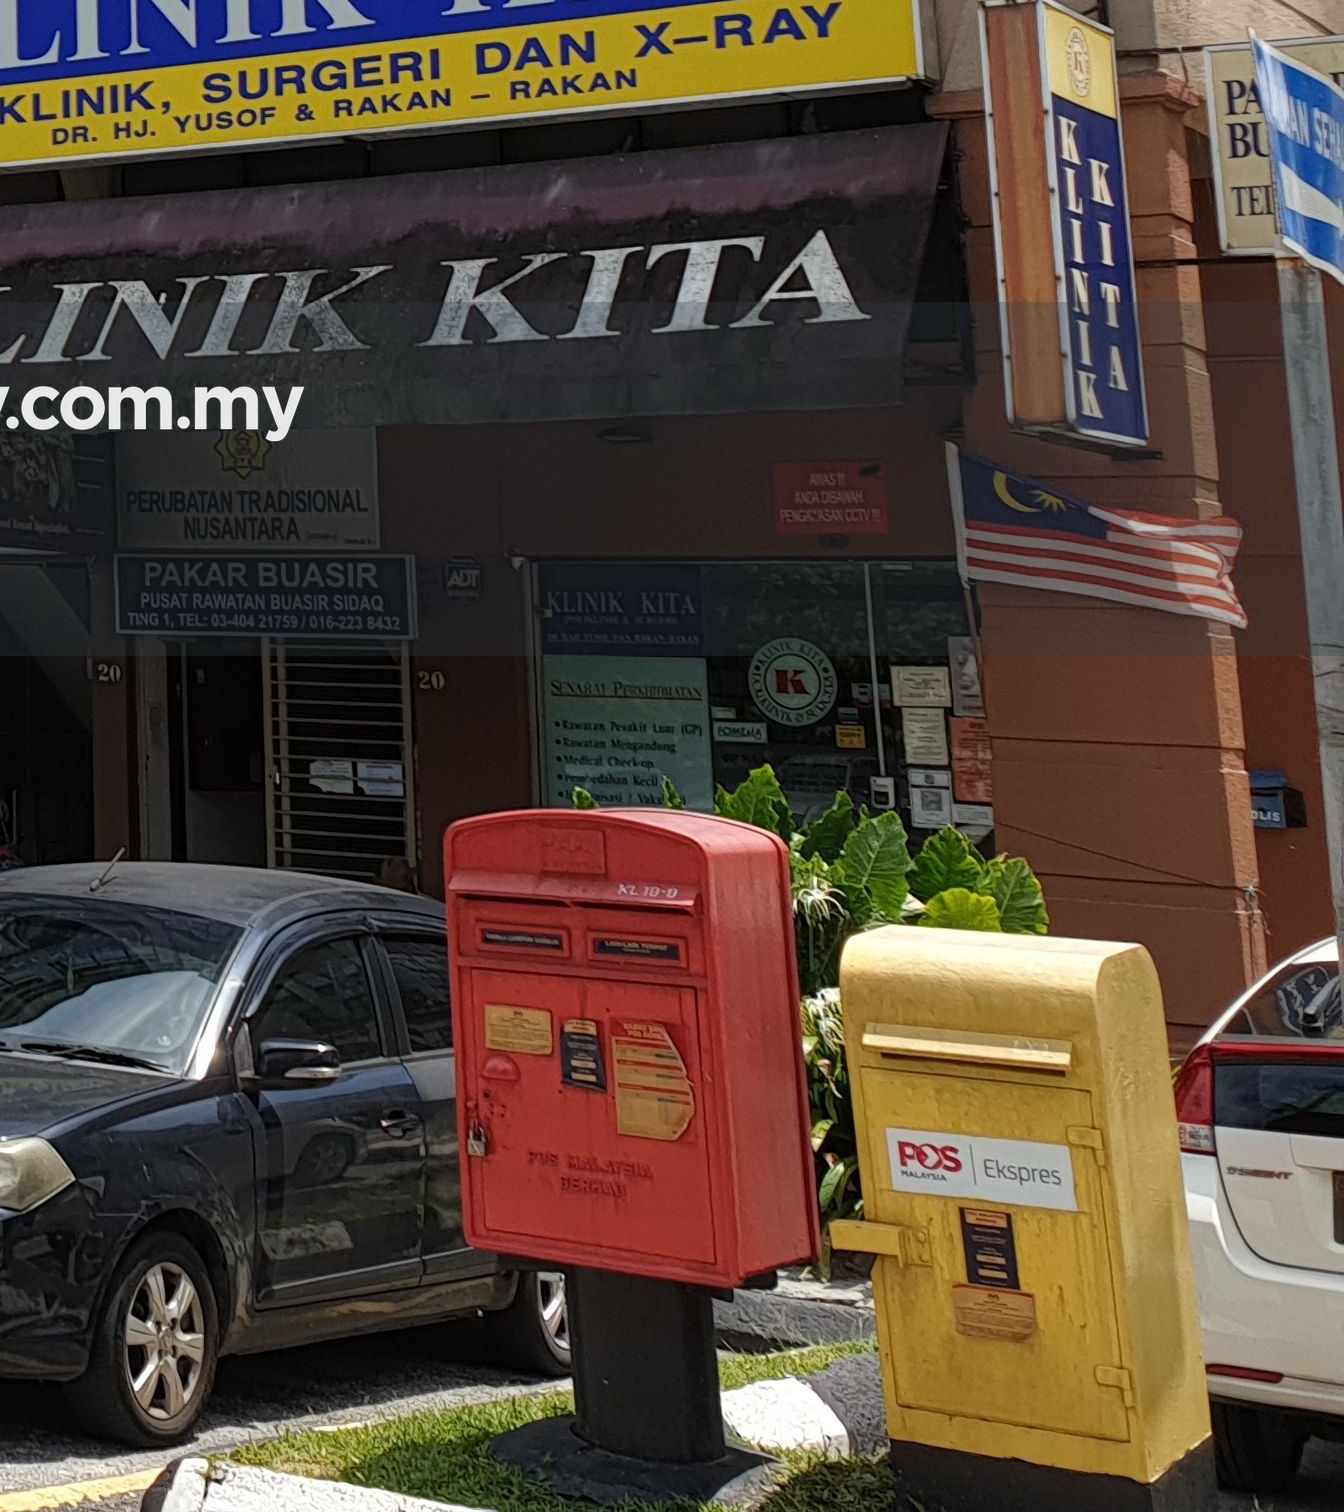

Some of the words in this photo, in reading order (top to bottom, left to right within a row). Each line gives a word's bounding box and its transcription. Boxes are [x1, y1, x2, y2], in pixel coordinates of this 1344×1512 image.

[201, 48, 442, 106] SURGERI
[475, 30, 596, 76] DAN
[635, 2, 843, 57] X-RAY
[50, 124, 99, 147] DR.
[112, 115, 155, 140] HJ.
[173, 104, 277, 133] YUSOF
[295, 101, 316, 122] &
[333, 88, 449, 120] RAKAN
[509, 66, 638, 100] RAKAN
[1058, 115, 1103, 420] KLINIK
[1088, 156, 1128, 393] KITA
[418, 229, 872, 348] KITA
[126, 490, 233, 514] PERUBATAN
[236, 489, 368, 513] TRADISIONAL
[845, 508, 870, 522] CCTV
[184, 517, 300, 540] NUSANTARA
[144, 562, 247, 587] PAKAR
[258, 562, 379, 589] BUASIR
[446, 569, 481, 588] ADT
[140, 592, 189, 609] PUSAT
[193, 593, 263, 610] RAWATAN
[271, 594, 330, 611] BUASIR
[333, 594, 384, 613] SIDAQ
[547, 591, 624, 614] KLINIK
[640, 591, 696, 615] KITA
[127, 613, 160, 627] TING
[177, 613, 208, 627] TEL:
[211, 614, 257, 628] 03-404
[259, 615, 298, 629] 21759
[309, 615, 364, 630] 016-223
[366, 616, 400, 630] 8432
[96, 663, 123, 684] 20
[418, 670, 445, 690] 20
[775, 669, 811, 695] K
[562, 720, 605, 731] Rawatan
[611, 721, 647, 733] Pesakit
[563, 738, 606, 748] Rawatan
[611, 739, 676, 753] Mengandung
[633, 775, 658, 786] Kecil
[897, 1141, 962, 1173] POS
[901, 1170, 947, 1182] MALAYSIA
[983, 1159, 1062, 1186] Ekspres
